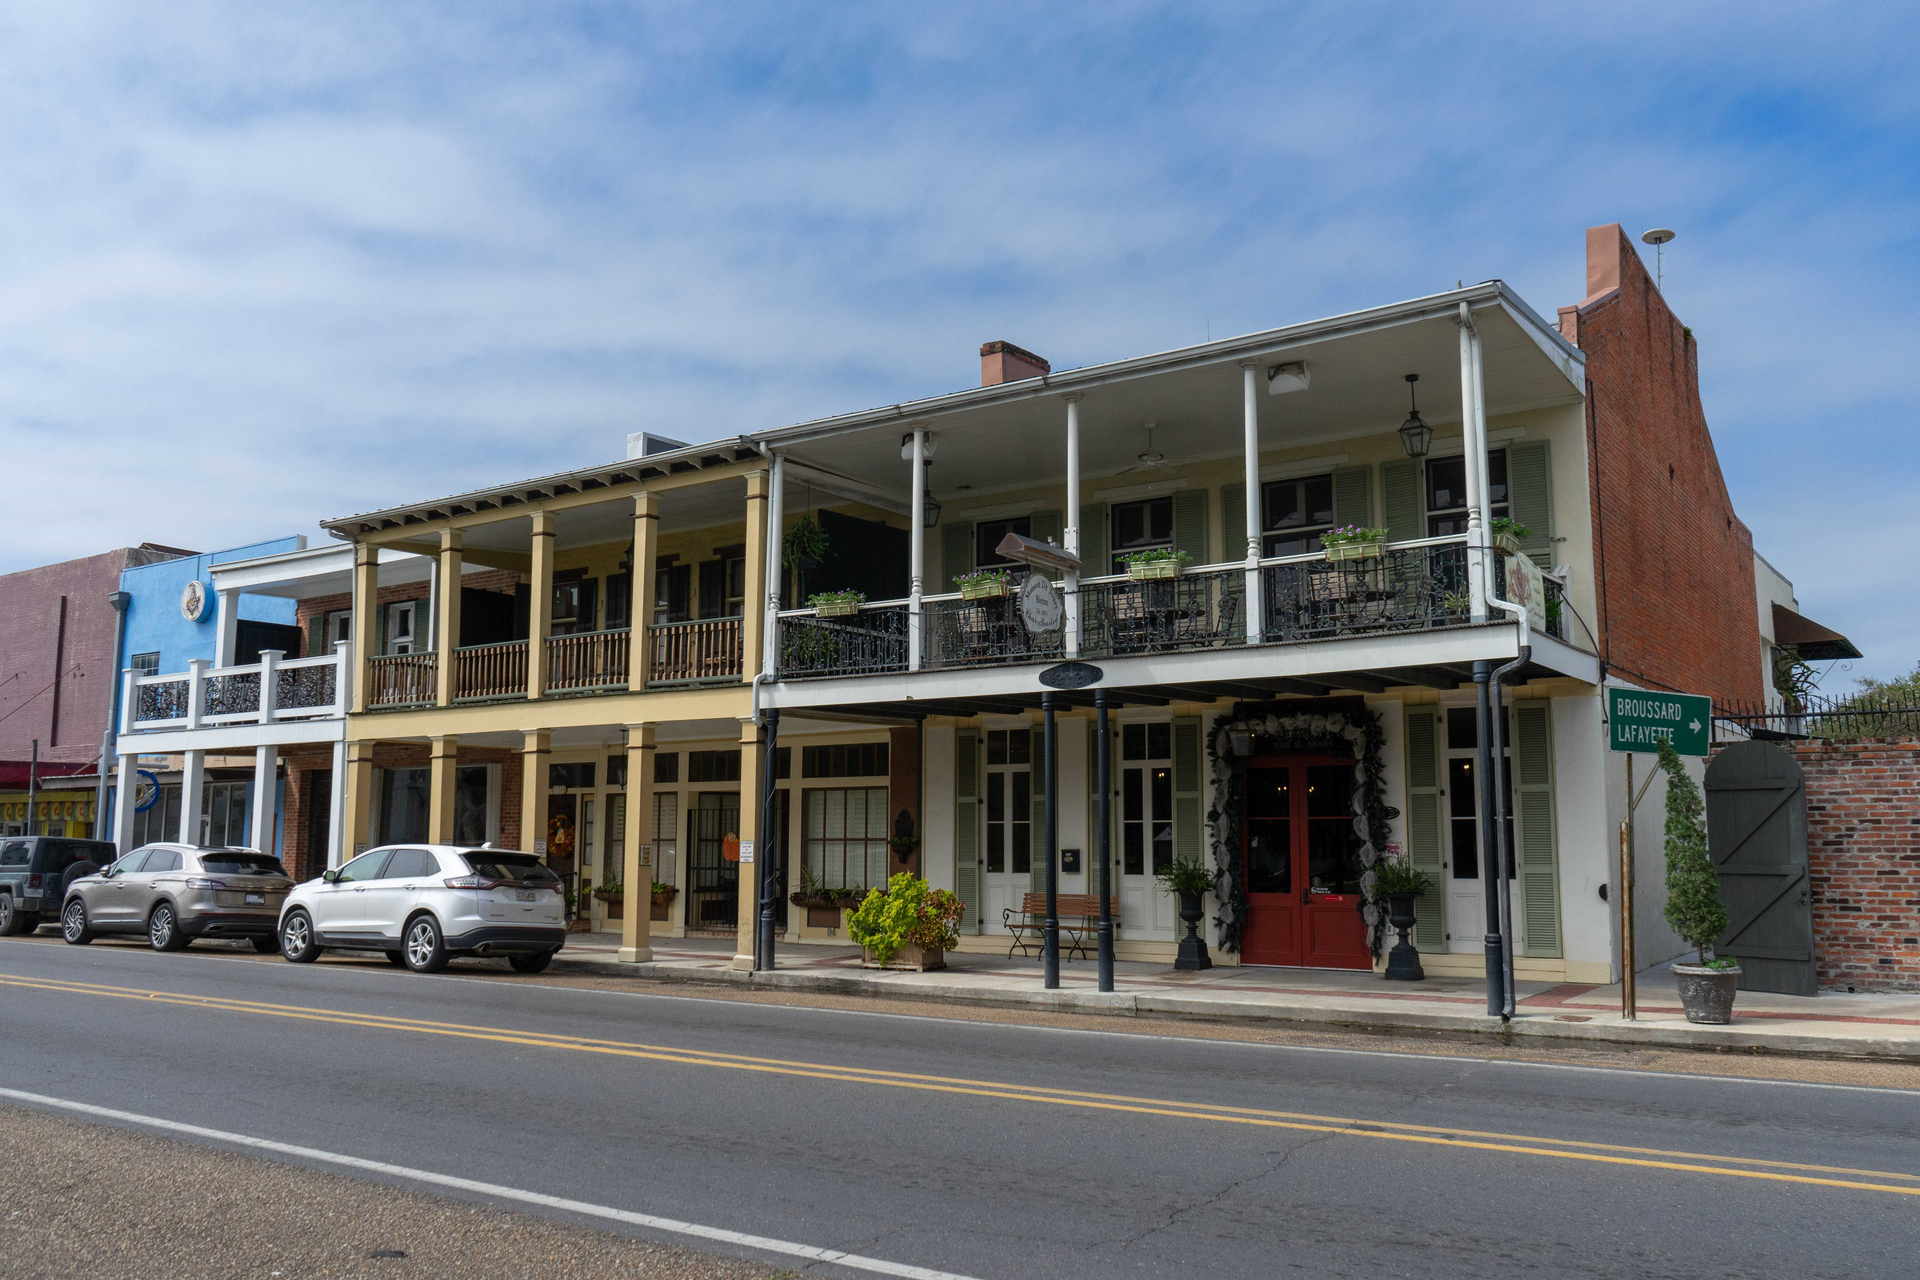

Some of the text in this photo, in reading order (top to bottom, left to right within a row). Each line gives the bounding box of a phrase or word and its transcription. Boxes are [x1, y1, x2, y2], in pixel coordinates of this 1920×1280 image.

[1617, 698, 1682, 720] BROUSSARD
[1307, 739, 1333, 748] Main
[1618, 724, 1675, 745] LAFAYETTE
